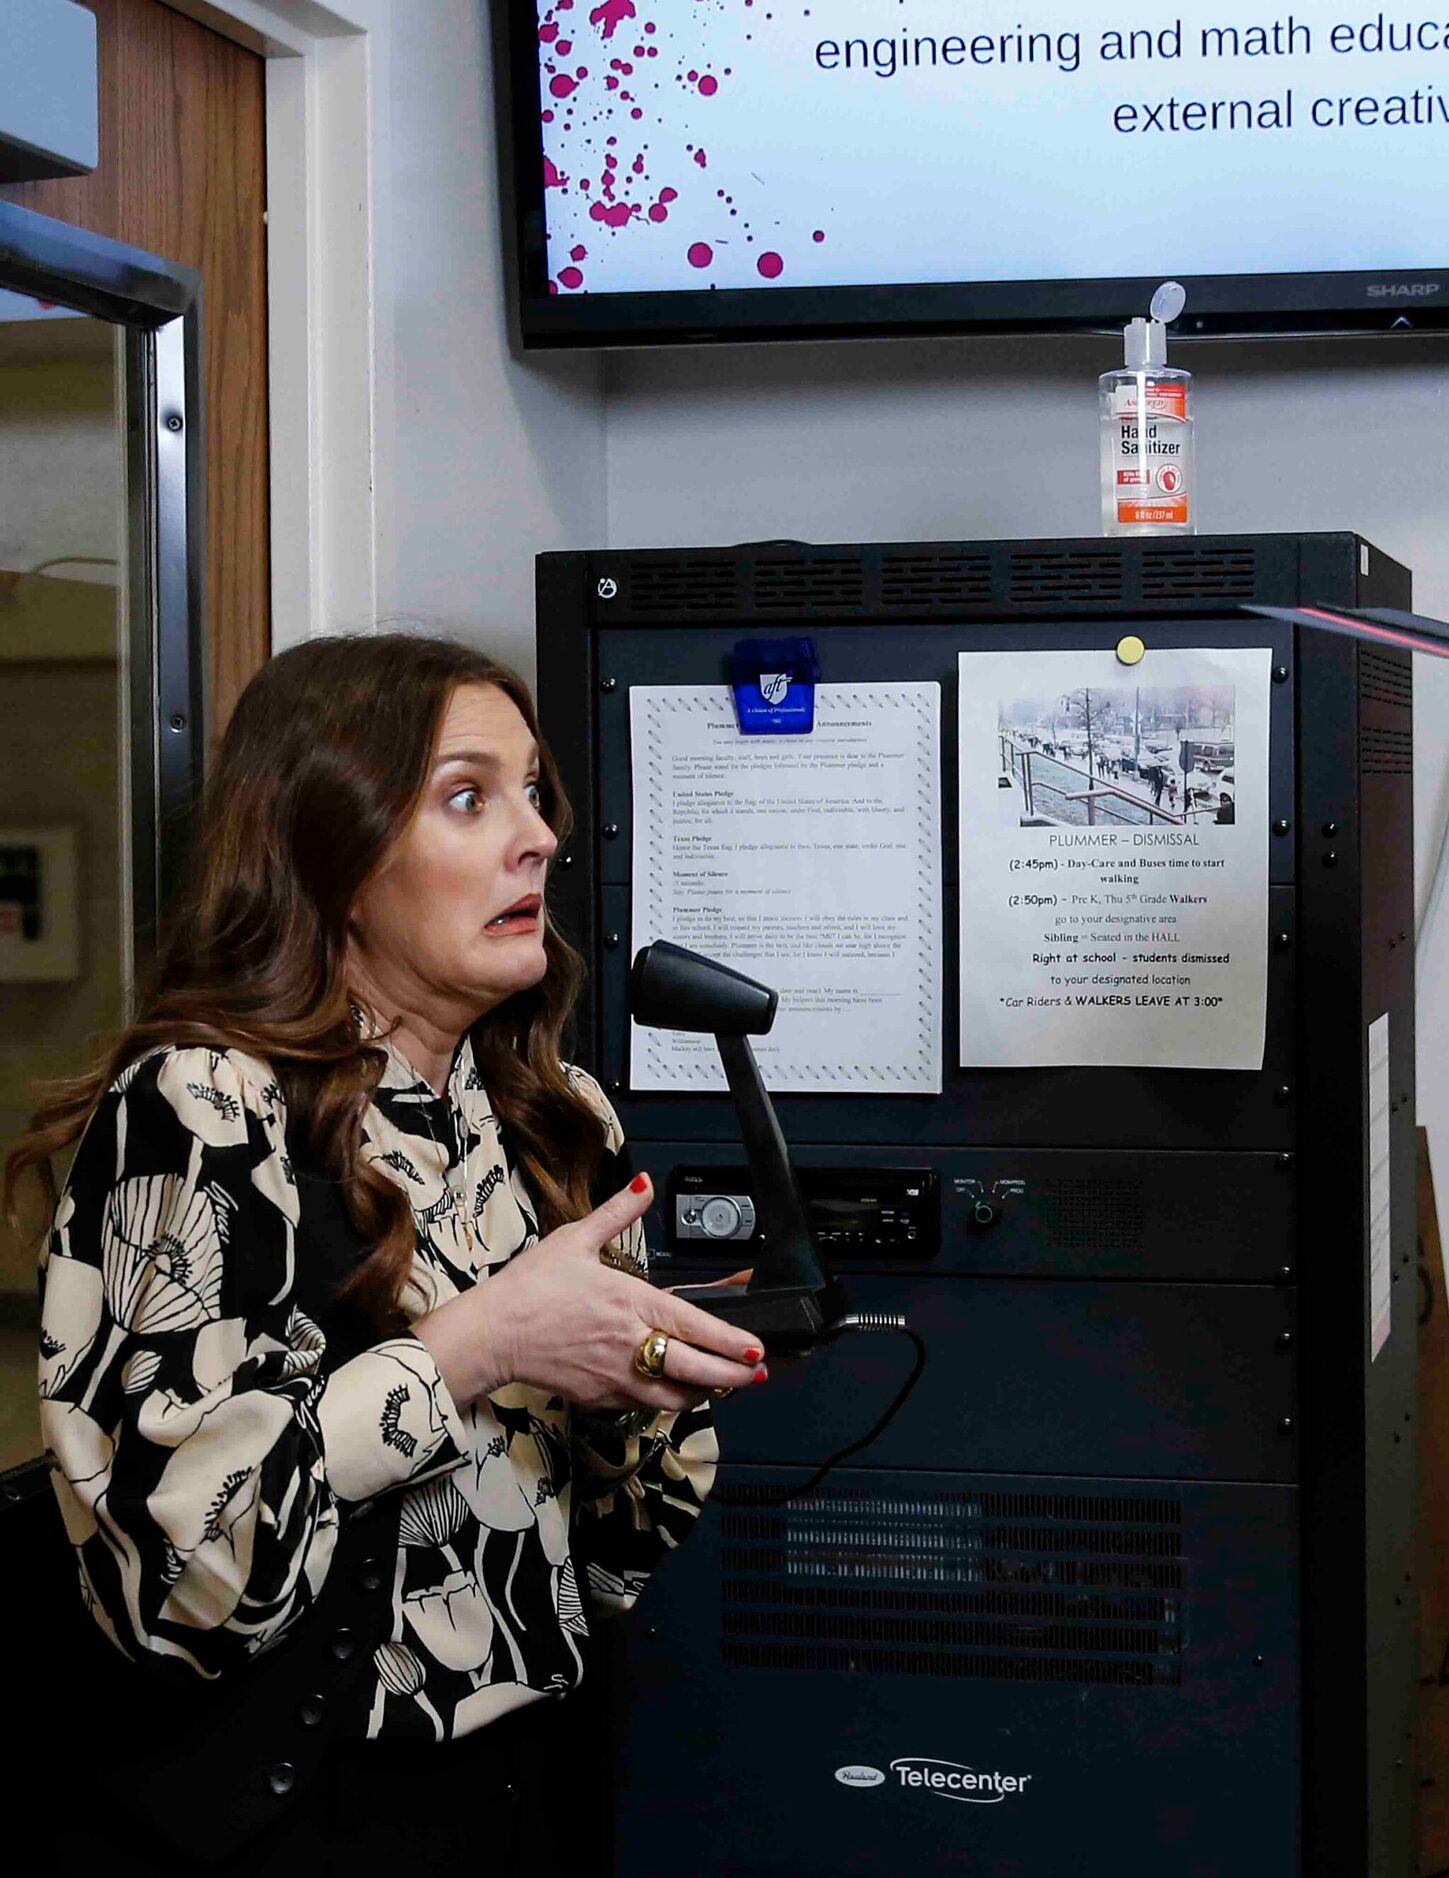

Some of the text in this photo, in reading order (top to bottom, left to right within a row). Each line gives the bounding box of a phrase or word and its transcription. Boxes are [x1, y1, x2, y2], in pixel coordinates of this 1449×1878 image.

[816, 25, 1079, 77] engineering
[1101, 20, 1180, 60] and
[1202, 16, 1310, 56] math
[1114, 90, 1291, 132] external
[1366, 284, 1439, 296] SHARP
[1122, 425, 1157, 439] Had
[1121, 440, 1180, 455] Saitizer
[1049, 835, 1118, 847] PLUMMER
[1133, 834, 1199, 846] DISMISSAL
[1009, 859, 1058, 870] (2:45pm)
[1068, 859, 1115, 870] Day-Care
[1118, 859, 1134, 868] and
[1139, 859, 1166, 868] Buses
[1168, 858, 1189, 868] time
[1202, 859, 1225, 867] start
[1100, 874, 1139, 884] walking
[1008, 895, 1057, 907] (2:50pm)
[1072, 895, 1087, 904] Pre
[1091, 894, 1101, 905] K,
[1104, 894, 1122, 904] Thu
[1125, 894, 1137, 904] 5th
[1140, 894, 1167, 904] Grade
[1170, 894, 1208, 904] Walkers
[1055, 917, 1066, 925] go
[1081, 916, 1102, 925] your
[1106, 914, 1156, 925] designative
[1044, 933, 1079, 943] Sibling
[1091, 933, 1121, 942] Seated
[1124, 933, 1132, 942] in
[1135, 933, 1149, 942] the
[1151, 932, 1180, 942] HALL
[1032, 953, 1061, 965] Right
[1066, 954, 1078, 962] at
[1083, 953, 1116, 963] school
[1132, 953, 1177, 963] students
[1181, 953, 1230, 963] dismissed
[1051, 975, 1190, 986] to your designated location
[1027, 997, 1061, 1006] Riders
[1064, 997, 1073, 1006] &
[1076, 995, 1131, 1006] WALKERS
[1135, 995, 1170, 1006] LEAVE
[1174, 996, 1189, 1006] AT
[896, 1766, 1028, 1792] Telecenter
